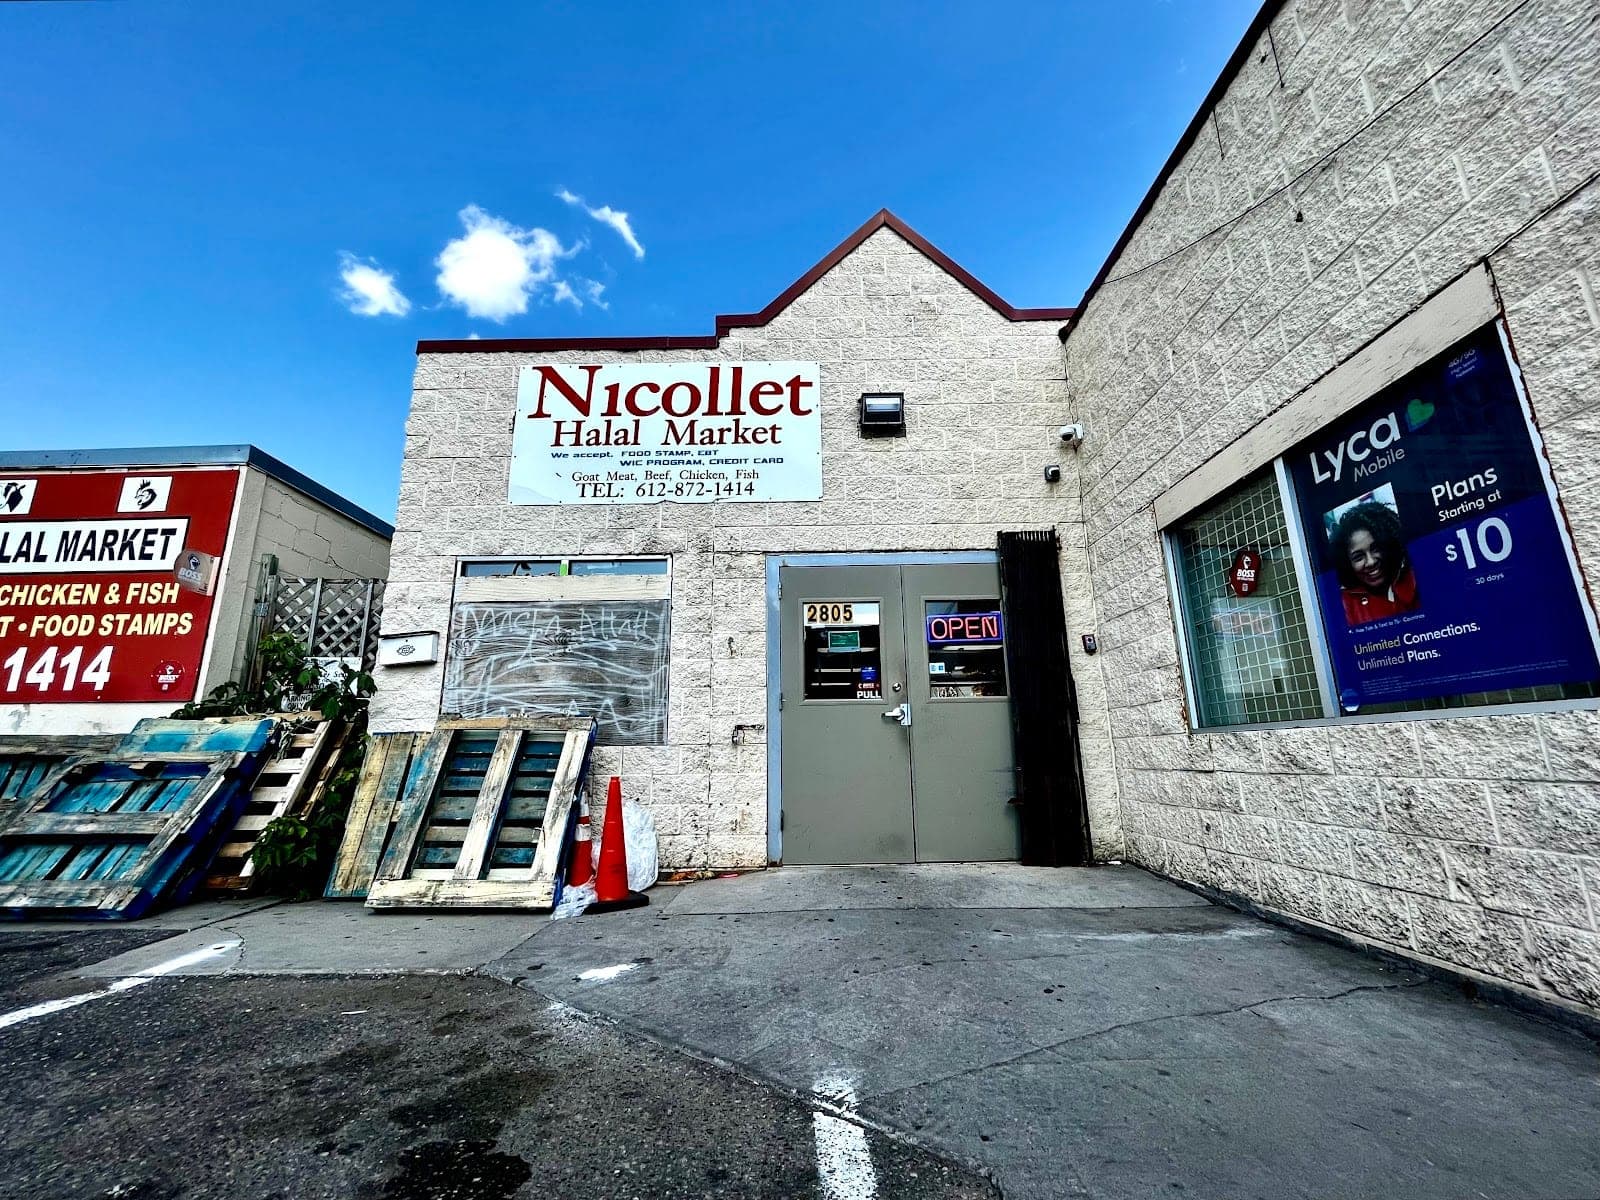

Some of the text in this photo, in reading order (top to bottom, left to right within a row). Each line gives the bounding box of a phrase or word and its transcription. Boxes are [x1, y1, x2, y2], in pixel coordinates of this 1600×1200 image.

[527, 365, 813, 418] Nicollet
[550, 418, 782, 447] Halal Market
[1309, 411, 1401, 484] Lyca
[572, 469, 759, 482] Goat Meat, Beef, Chicken, Fish
[1354, 448, 1405, 482] Mobile
[576, 481, 755, 498] TEL: 612-872-1414
[1431, 467, 1498, 506] Plans
[1438, 489, 1502, 522] Starting at
[55, 527, 178, 562] MARKET
[1445, 517, 1513, 569] $10
[178, 567, 203, 581] BOSS
[1237, 569, 1256, 577] BOSS
[1486, 572, 1505, 582] days
[0, 582, 180, 606] CHICKEN & FISH
[30, 614, 96, 637] FOOD
[99, 612, 194, 636] STAMPS
[807, 604, 853, 623] 2805
[931, 616, 998, 640] OPEN
[1354, 622, 1481, 655] Unlimited Connections.
[3, 645, 115, 692] 1414
[1358, 649, 1441, 671] Unlimited Plans.
[857, 690, 882, 699] PULL
